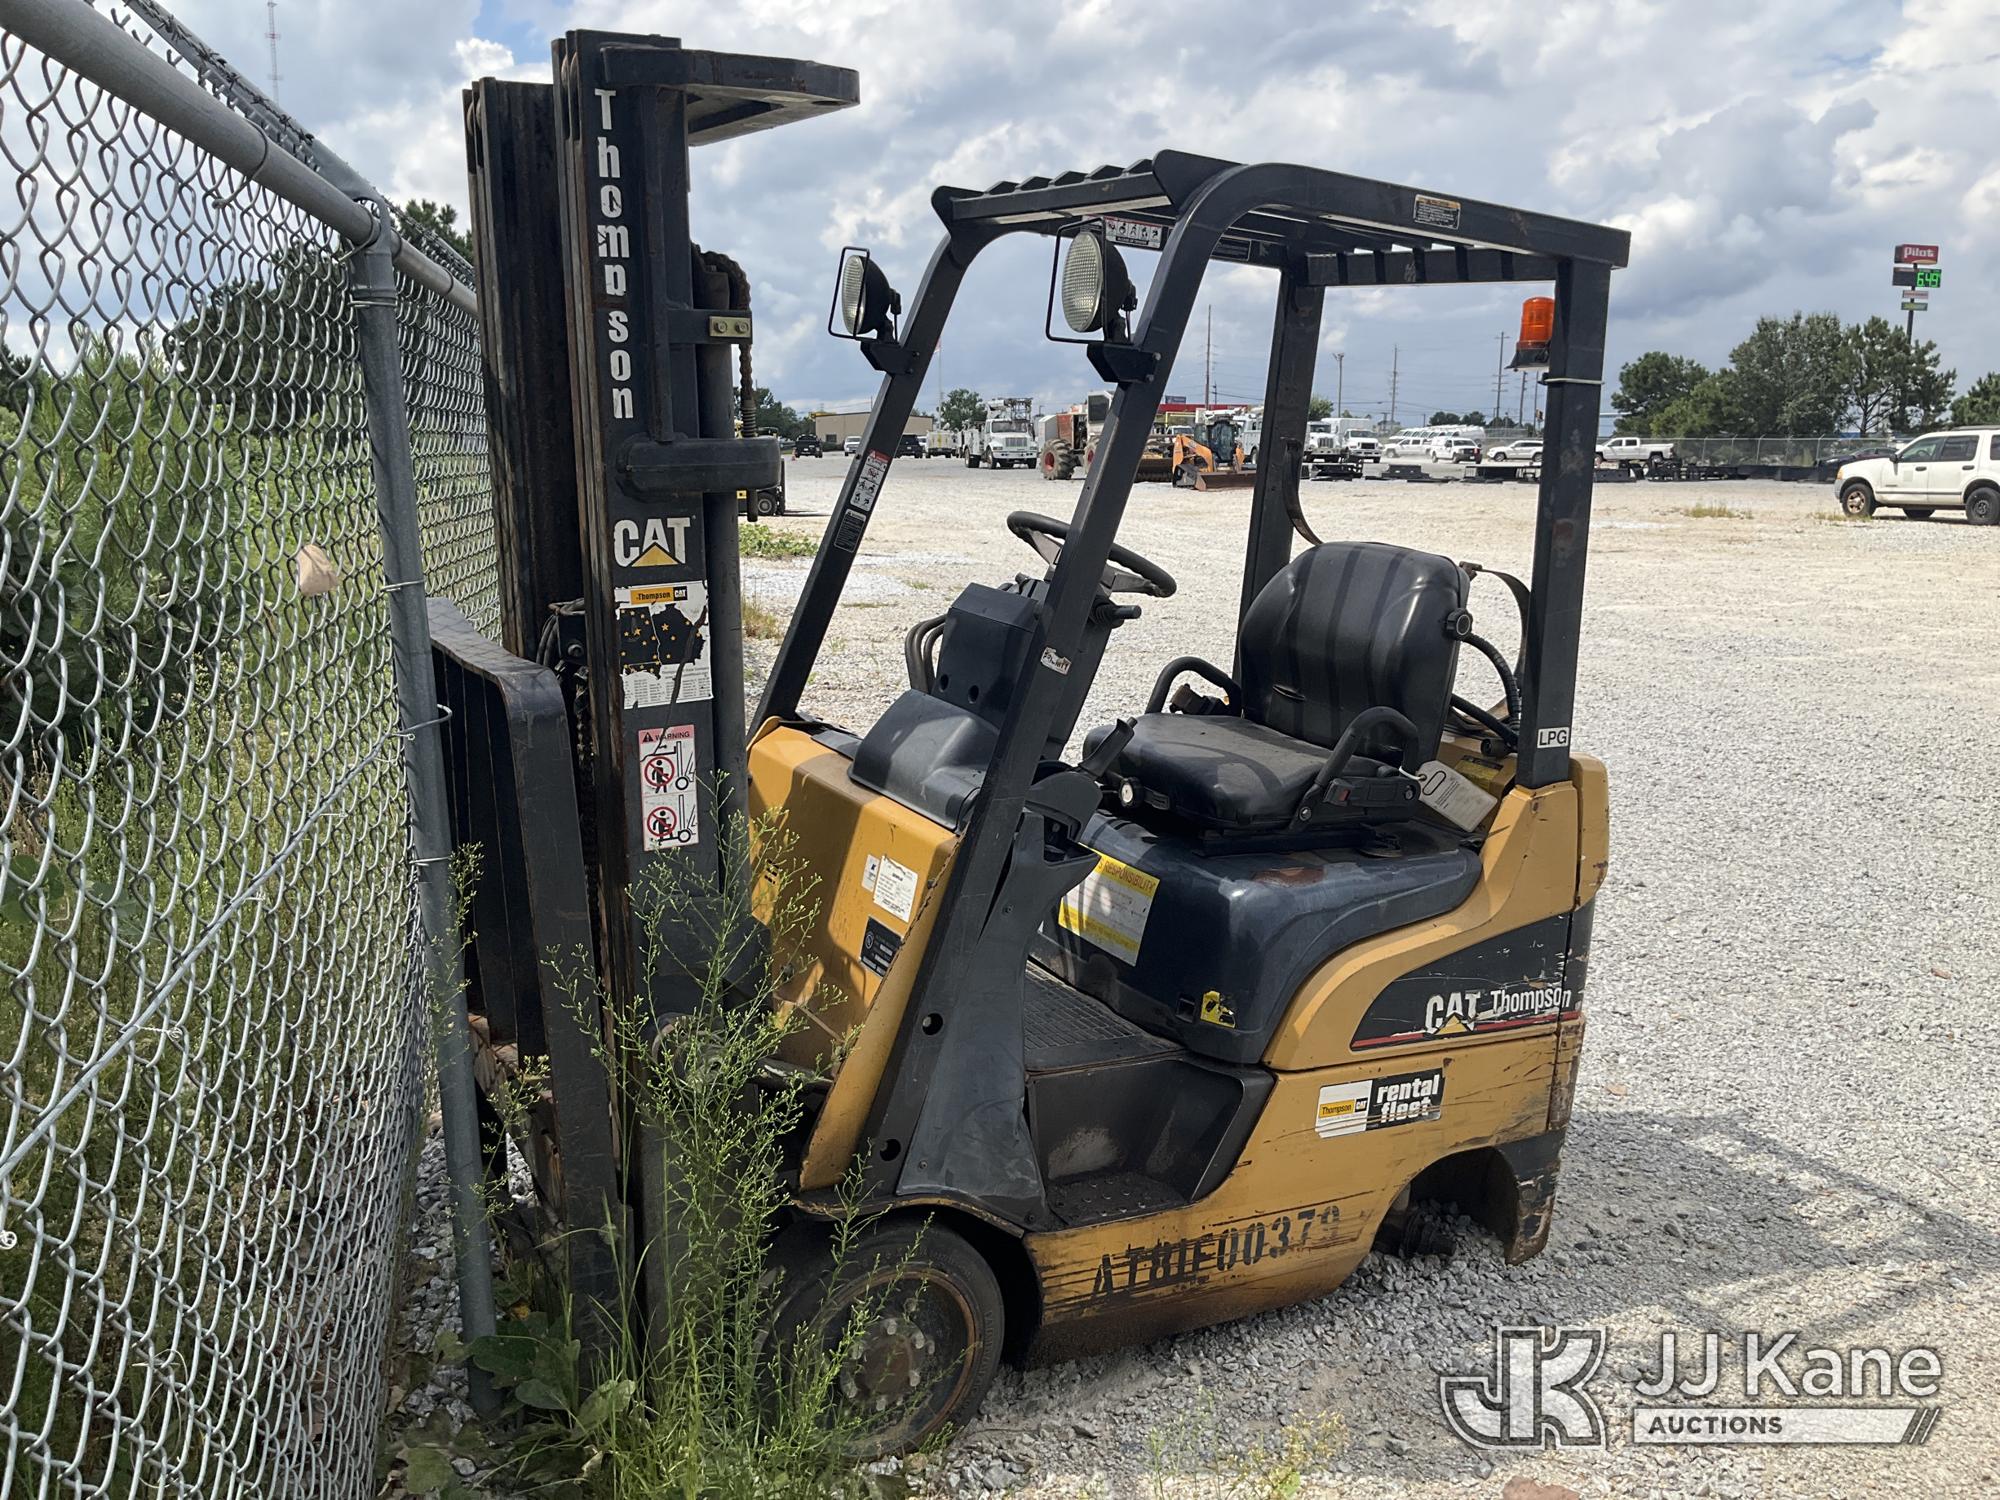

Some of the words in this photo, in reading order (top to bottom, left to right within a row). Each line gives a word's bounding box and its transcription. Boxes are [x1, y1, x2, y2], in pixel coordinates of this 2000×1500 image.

[594, 88, 634, 419] Thompson
[1904, 247, 1935, 259] Pilot
[613, 517, 691, 567] CAT
[638, 592, 671, 601] Thompson
[674, 589, 687, 598] CAT
[1538, 730, 1568, 746] LPG
[1425, 991, 1481, 1034] CAT
[1490, 987, 1572, 1014] Thompson
[1376, 1074, 1440, 1104] rental
[1322, 1103, 1352, 1115] Thompson
[1355, 1099, 1368, 1110] CAT
[1381, 1097, 1432, 1123] fleet
